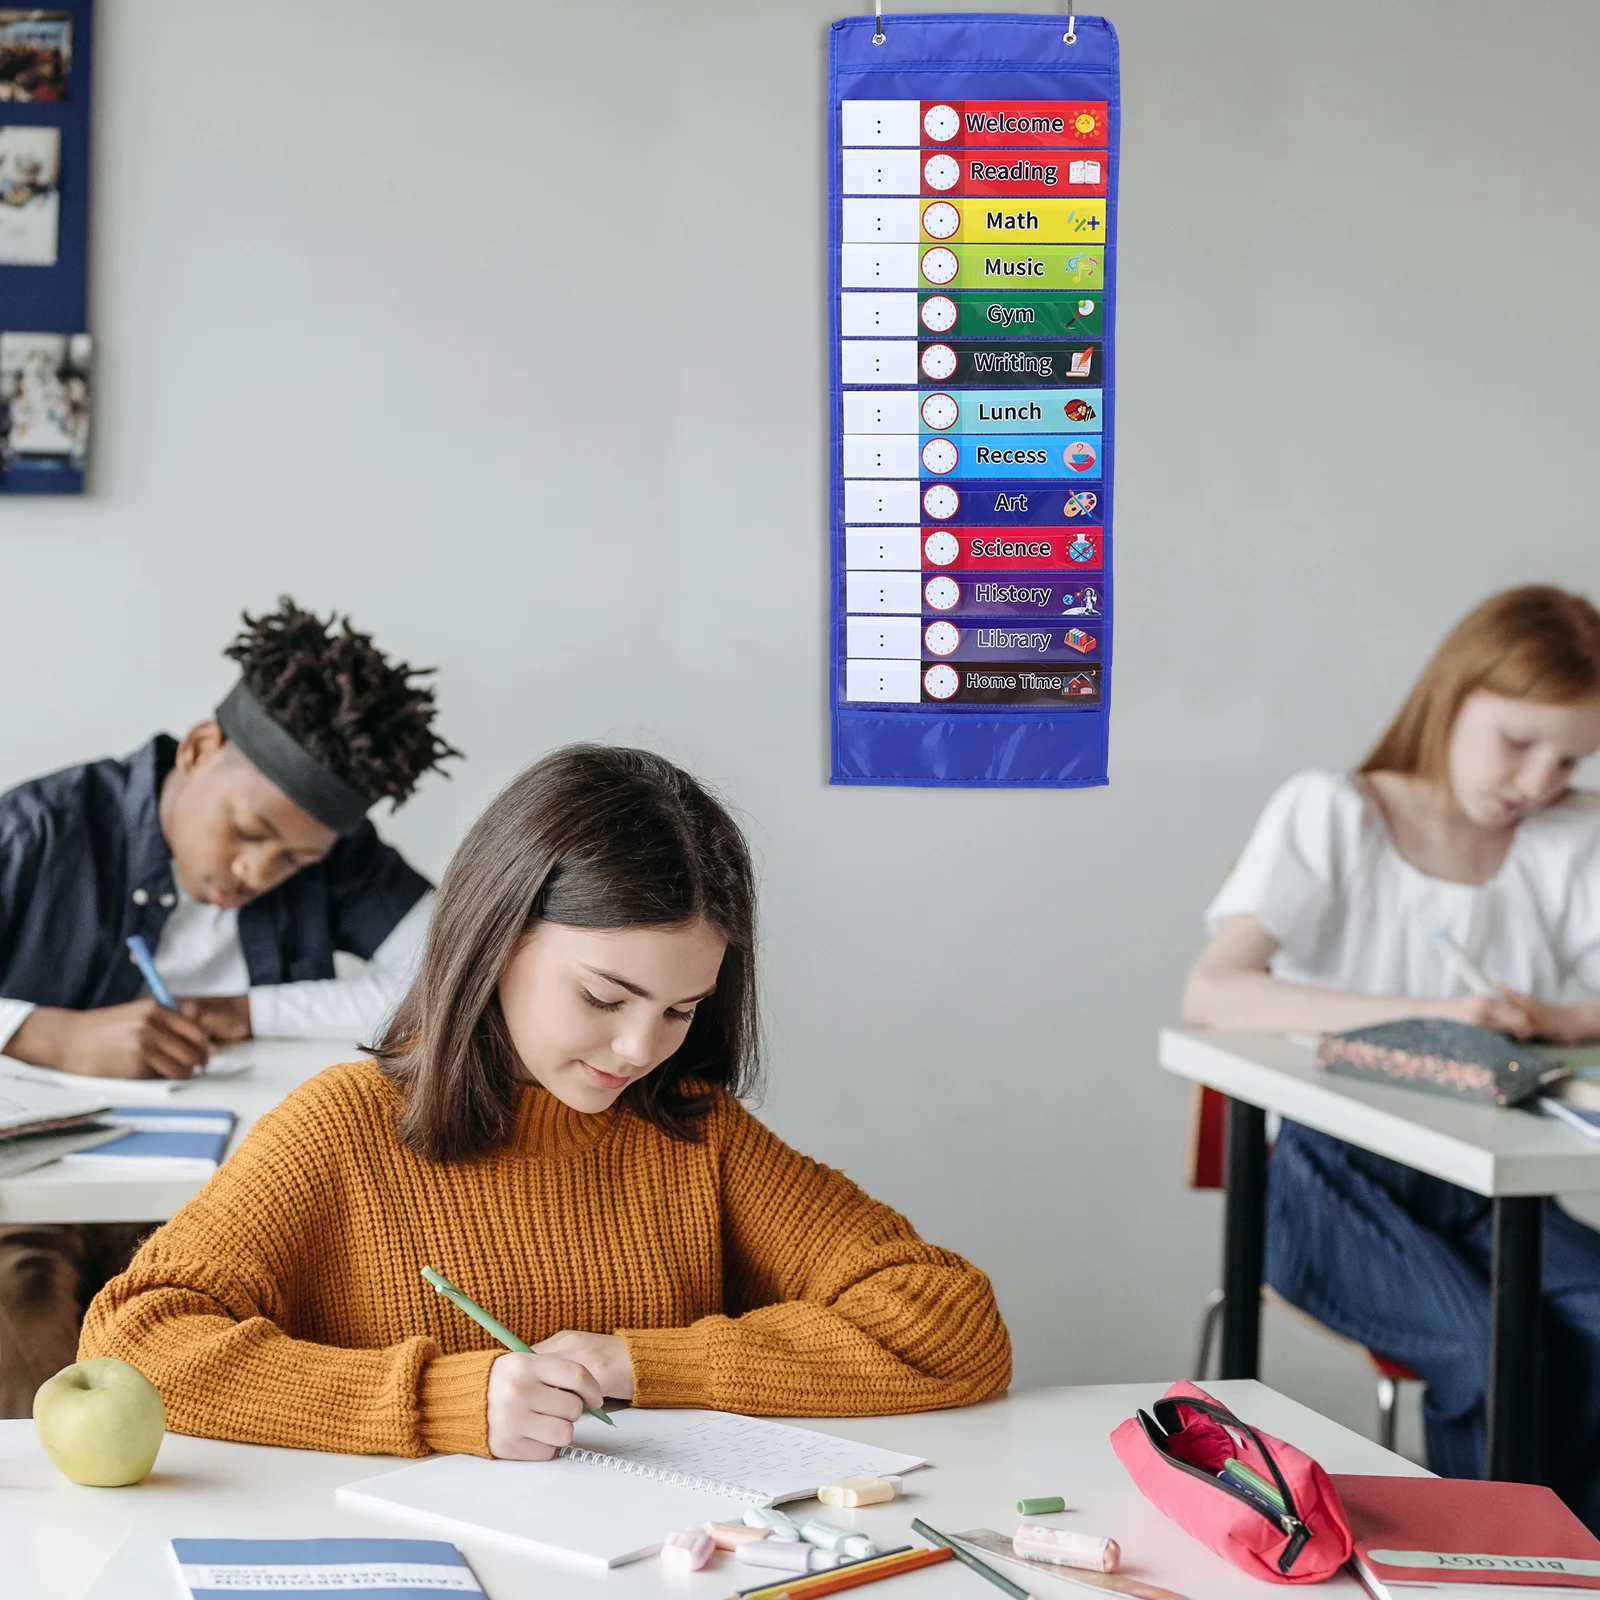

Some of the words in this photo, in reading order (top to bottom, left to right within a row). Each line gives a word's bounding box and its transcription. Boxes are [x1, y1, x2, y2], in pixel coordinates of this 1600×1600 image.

[965, 113, 1064, 133] Welcome
[970, 161, 1057, 185] Reading
[985, 211, 1038, 230] Math
[984, 257, 1045, 277] Music
[986, 304, 1035, 326] Gym
[974, 352, 1052, 376] Writing
[978, 402, 1042, 421] Lunch
[976, 446, 1047, 465] Recess
[994, 493, 1028, 512] Art
[971, 538, 1051, 557] Science
[975, 585, 1052, 606] History
[977, 629, 1052, 651] Library
[966, 673, 1016, 690] Home
[1019, 673, 1061, 690] Time
[1436, 1555, 1565, 1571] BIOLOGY
